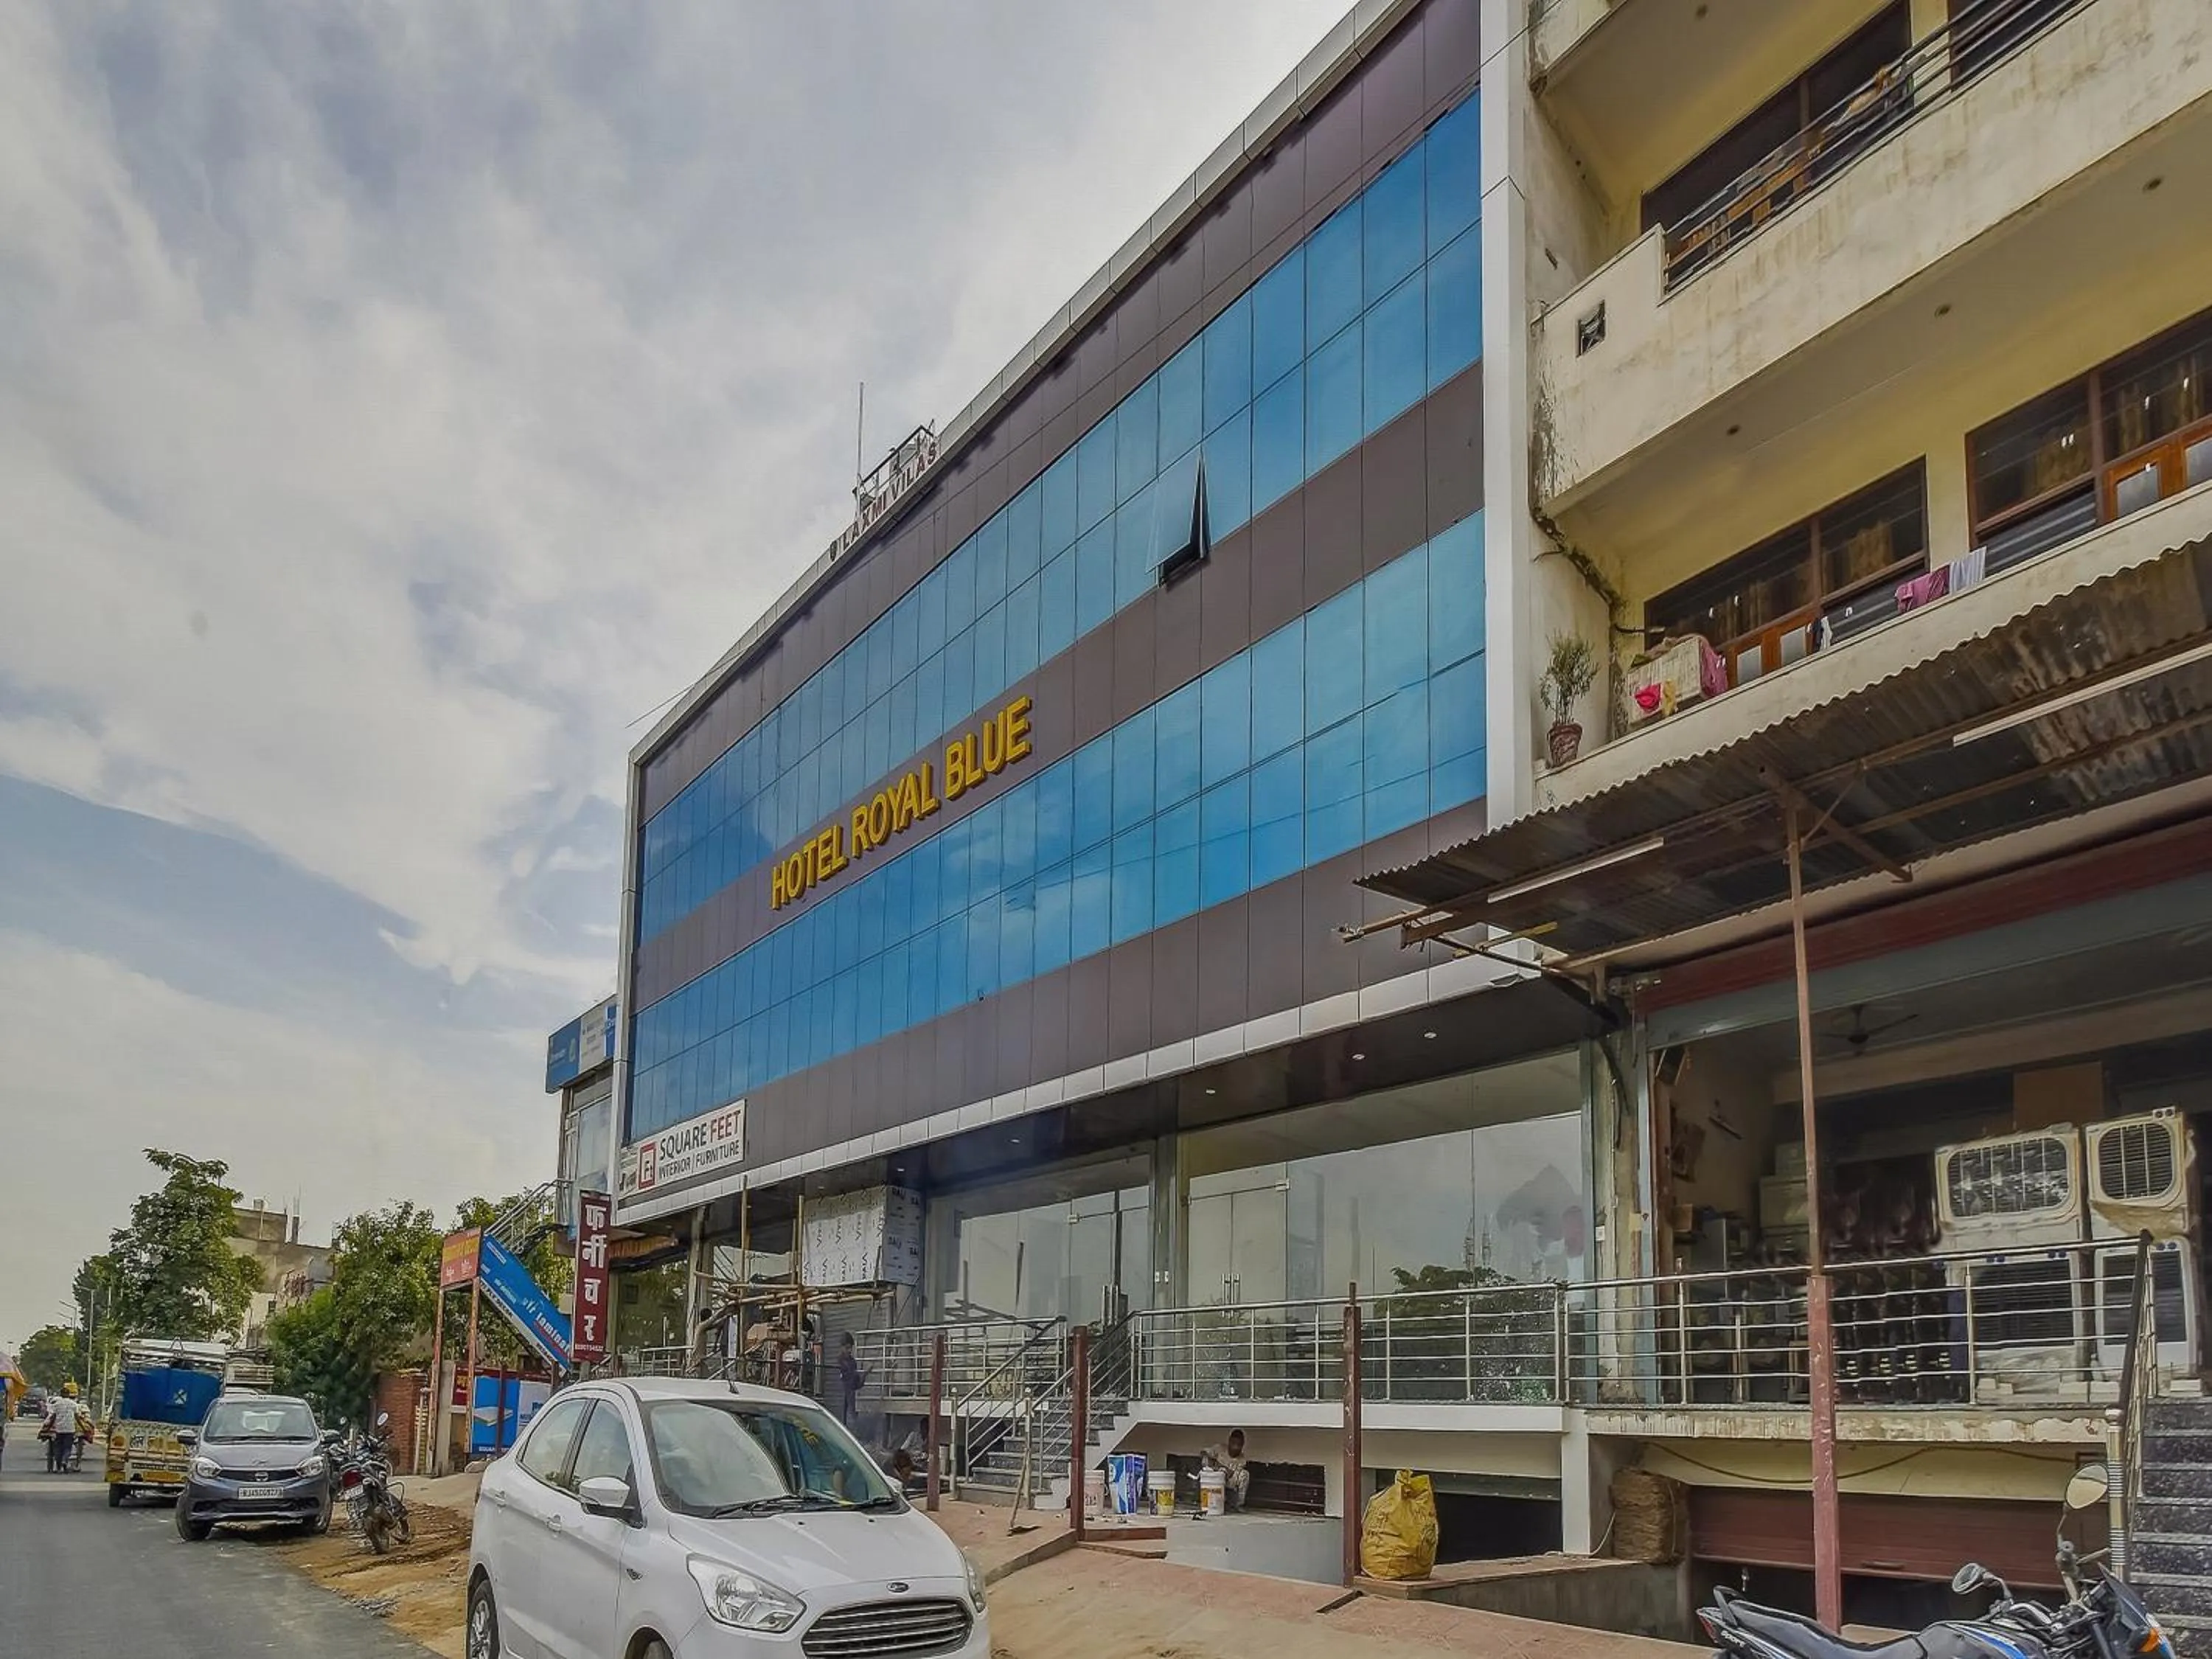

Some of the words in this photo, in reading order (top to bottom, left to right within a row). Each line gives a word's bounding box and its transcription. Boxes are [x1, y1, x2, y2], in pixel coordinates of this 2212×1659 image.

[891, 442, 937, 501] VILAS
[770, 824, 849, 910] HOTEL
[851, 761, 941, 858] ROYAL
[945, 695, 1033, 801] BLUE
[659, 1157, 691, 1180] INTERIOR
[695, 1140, 740, 1168] FURNITURE
[660, 1121, 707, 1161] SQUARE
[709, 1110, 741, 1144] FEET
